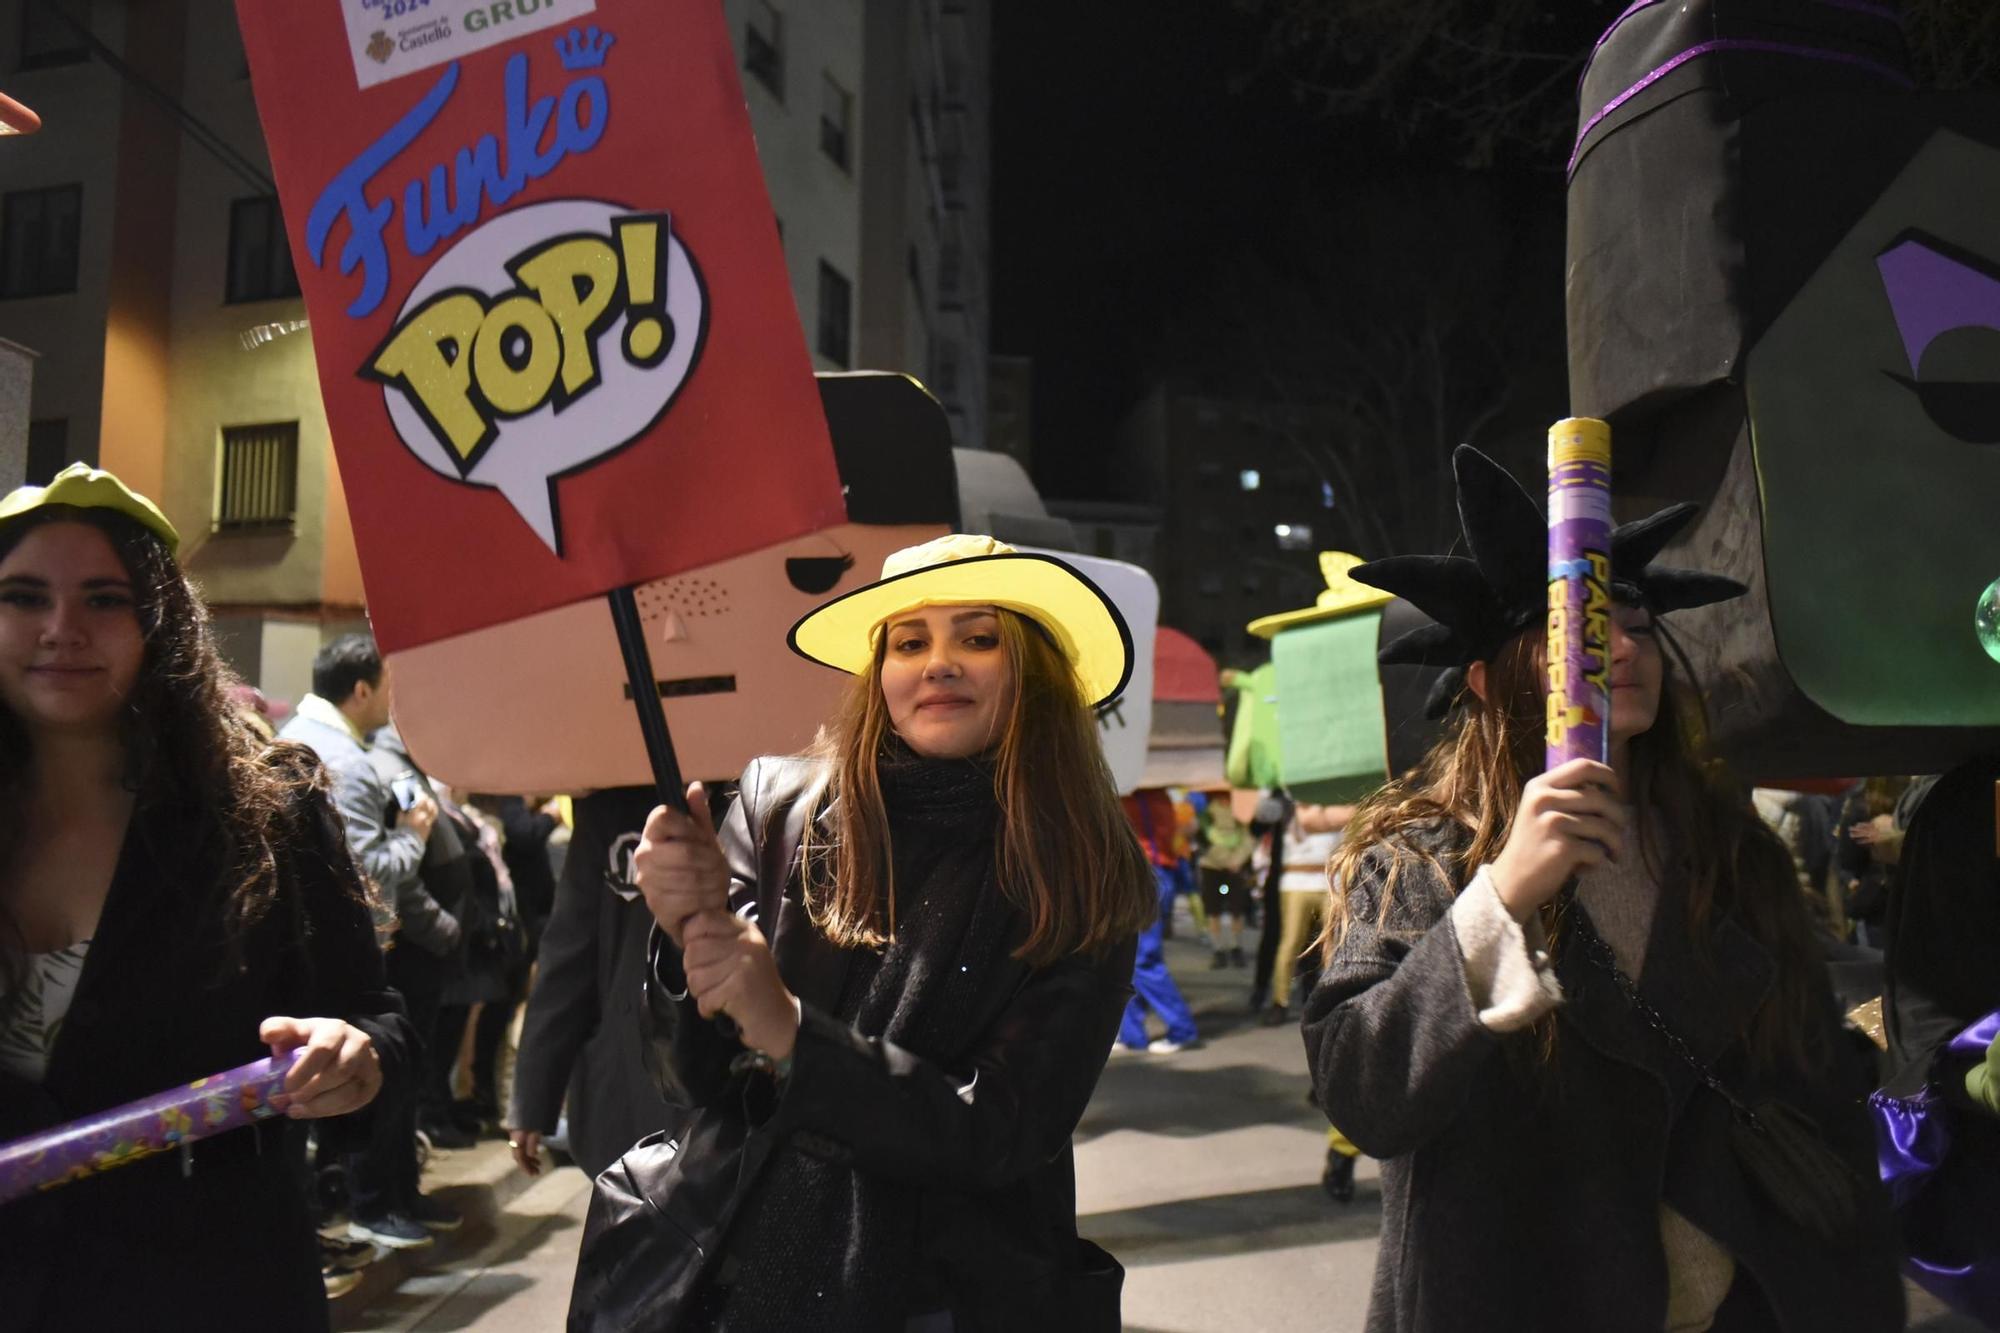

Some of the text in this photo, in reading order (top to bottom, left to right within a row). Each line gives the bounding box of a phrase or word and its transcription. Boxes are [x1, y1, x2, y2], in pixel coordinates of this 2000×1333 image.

[307, 53, 608, 318] Funko
[358, 214, 675, 479] POP!
[1582, 550, 1610, 697] PARTY
